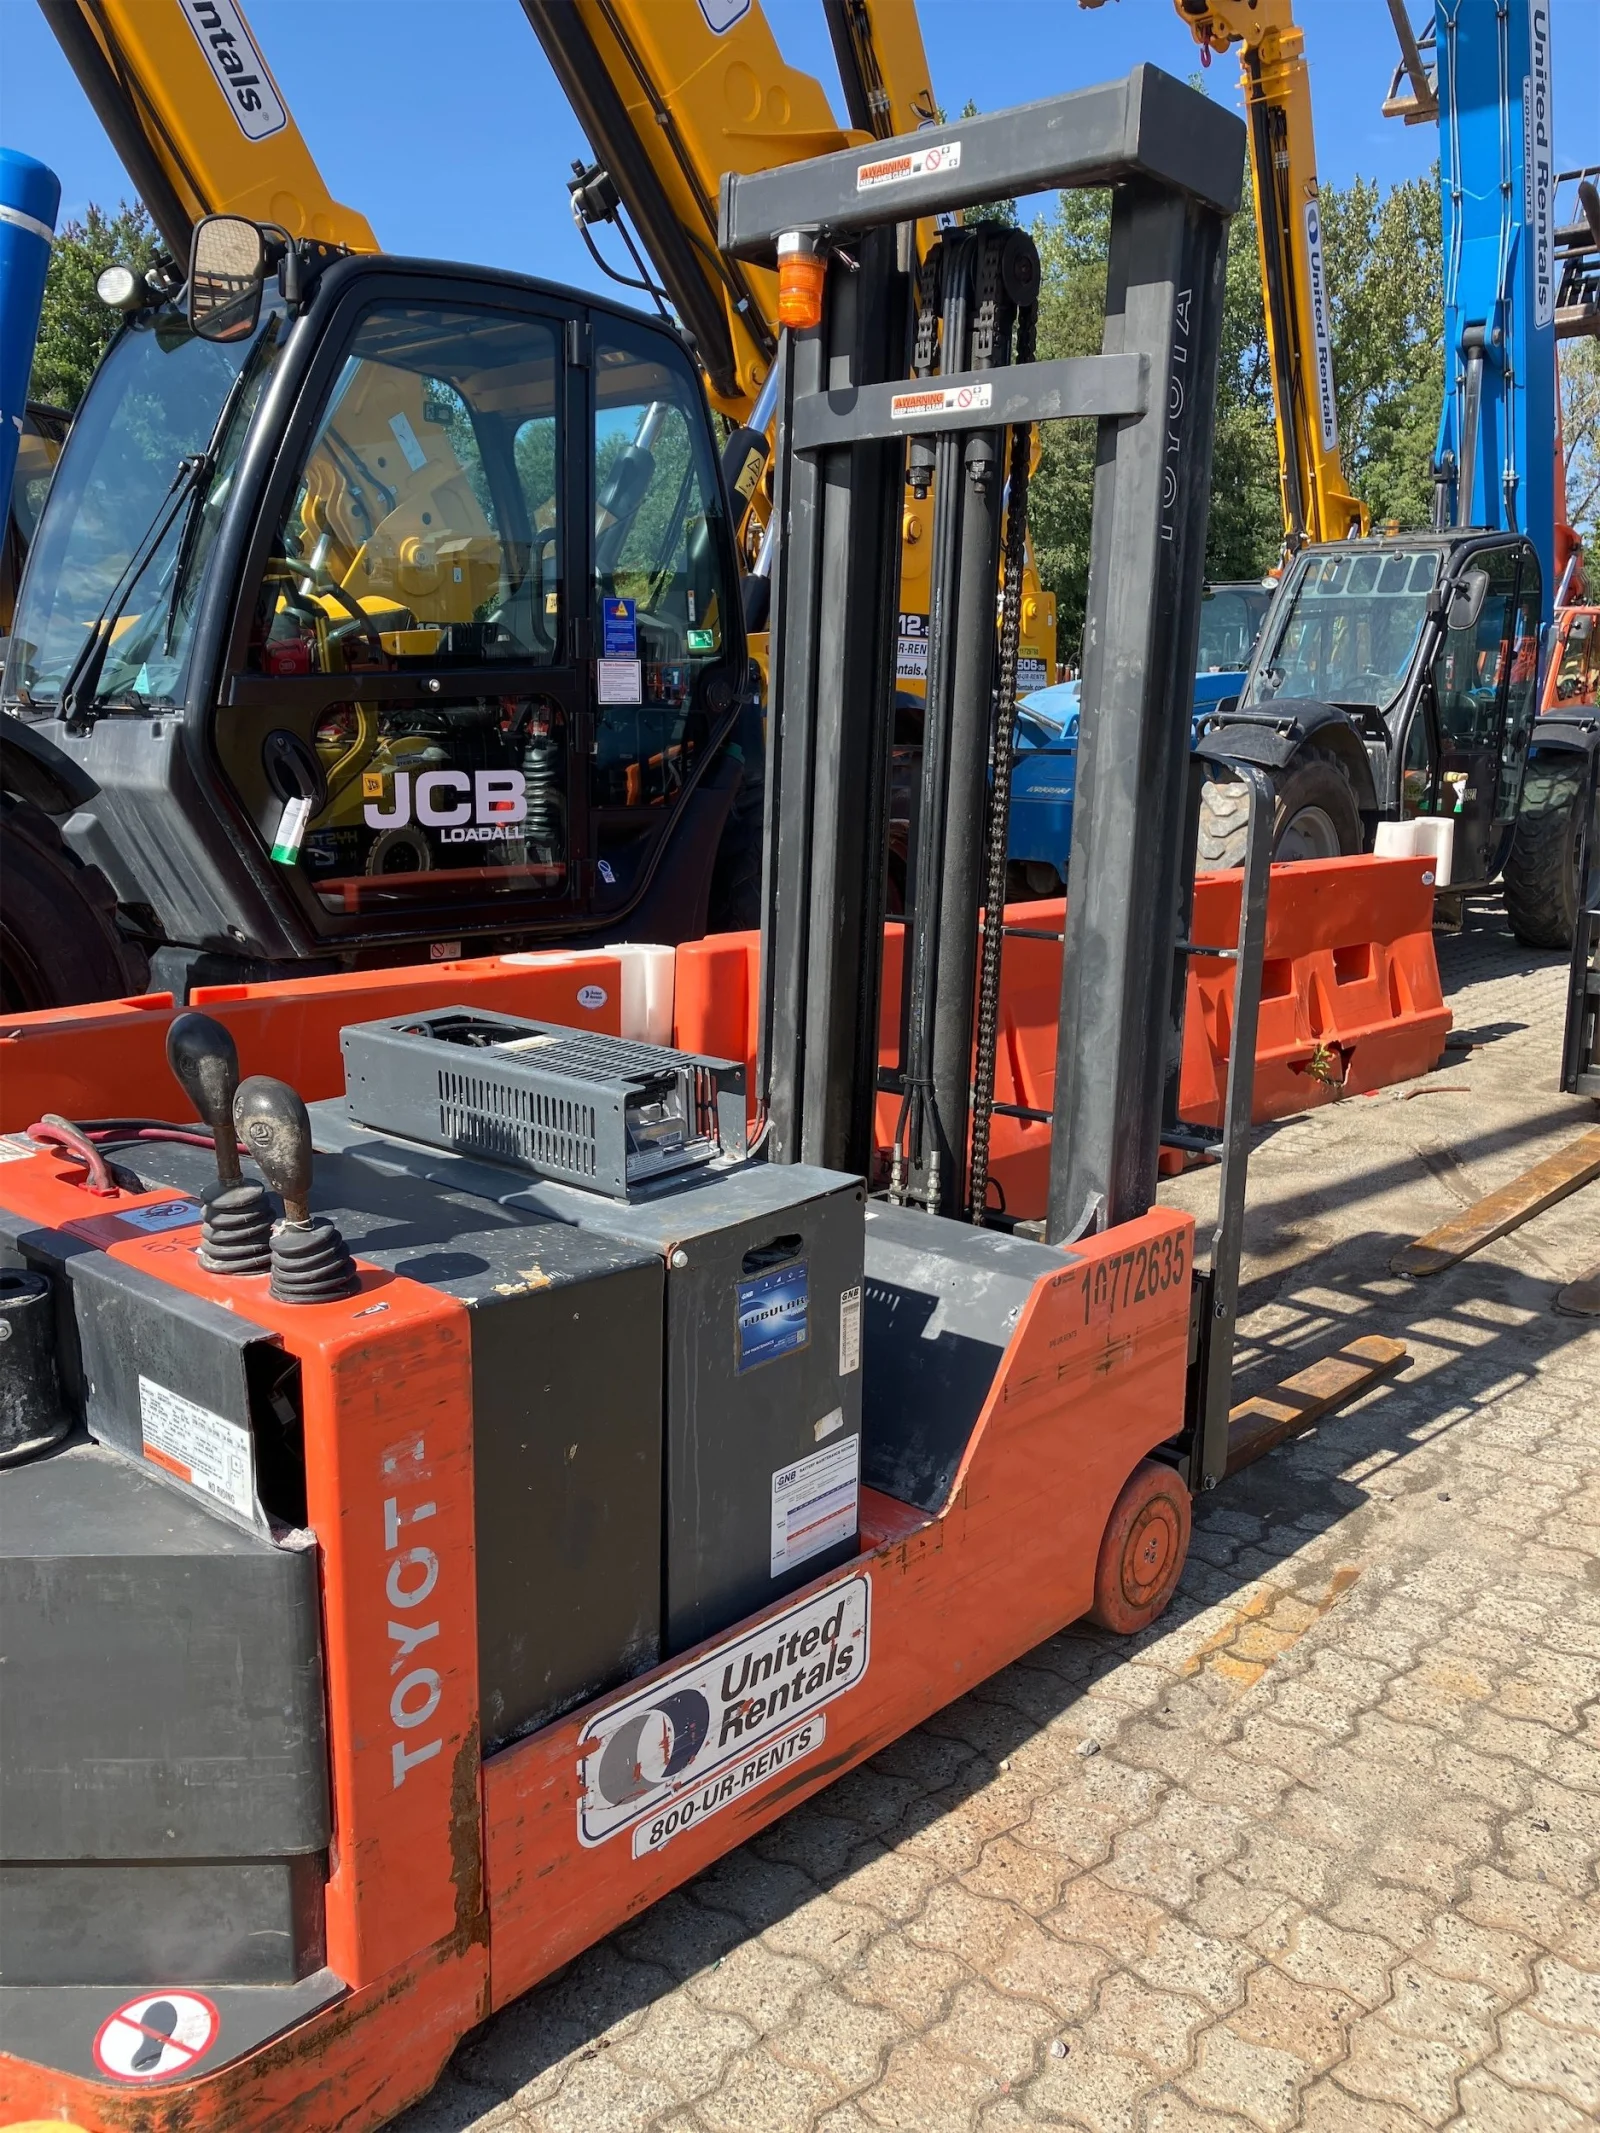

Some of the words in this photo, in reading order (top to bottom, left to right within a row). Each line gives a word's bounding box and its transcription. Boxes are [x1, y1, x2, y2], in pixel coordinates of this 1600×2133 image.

[1533, 10, 1548, 148] United
[868, 157, 910, 177] WARNING
[1537, 160, 1550, 306] Rentals
[1311, 252, 1326, 338] United
[902, 393, 943, 406] WARNING
[1318, 346, 1333, 437] Rentals
[363, 769, 528, 830] JCB
[440, 826, 525, 843] LOADALL
[743, 1295, 805, 1328] TUBULAR
[842, 1288, 859, 1301] GNB
[1081, 1230, 1185, 1325] 10772635
[208, 1480, 216, 1493] NO
[216, 1485, 235, 1505] RIDING
[777, 1470, 796, 1486] GNB
[720, 1599, 846, 1702] United
[718, 1644, 854, 1749] Rentals
[649, 1726, 812, 1846] 800-UR-RENTS
